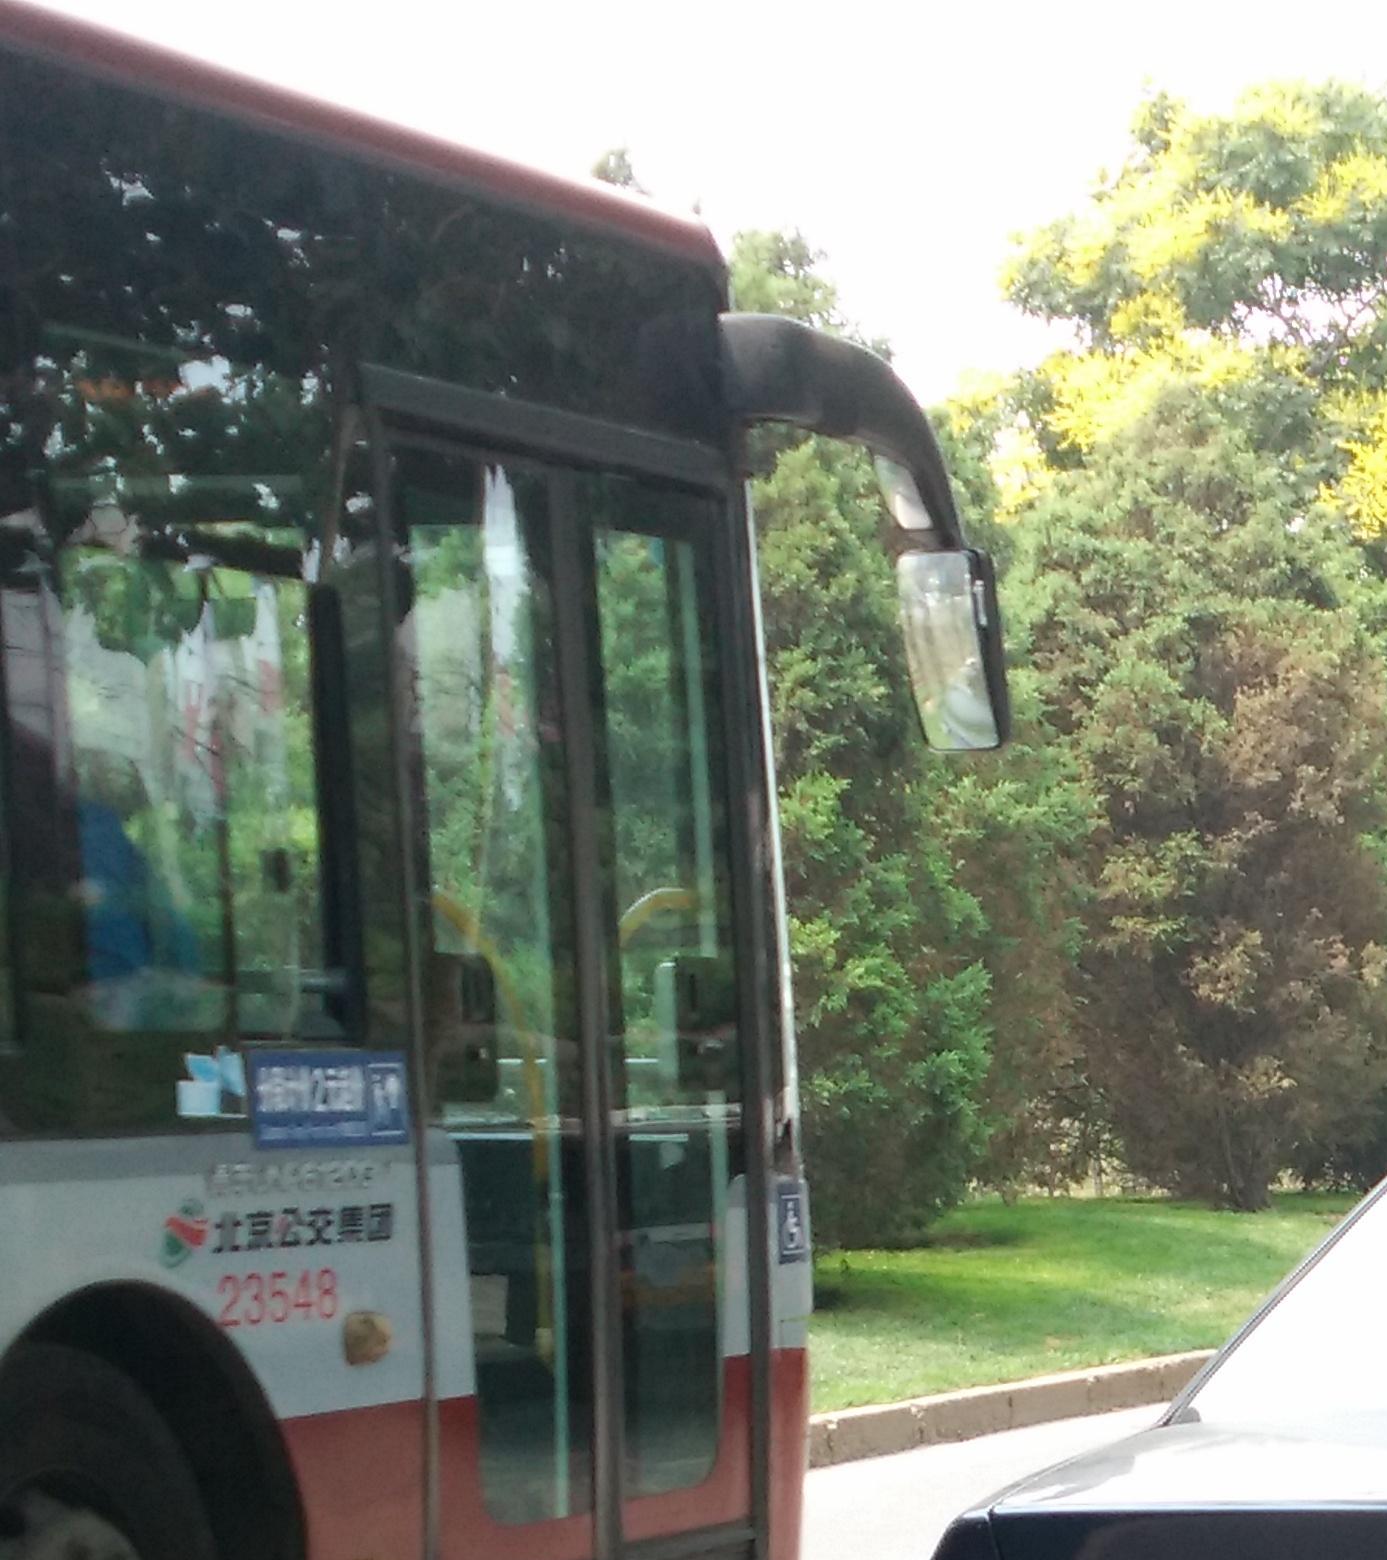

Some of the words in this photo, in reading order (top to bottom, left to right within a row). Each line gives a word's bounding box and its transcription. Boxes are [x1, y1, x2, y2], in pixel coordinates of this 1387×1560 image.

[213, 1204, 392, 1253] 北京公交集团
[217, 1267, 338, 1326] 23548
